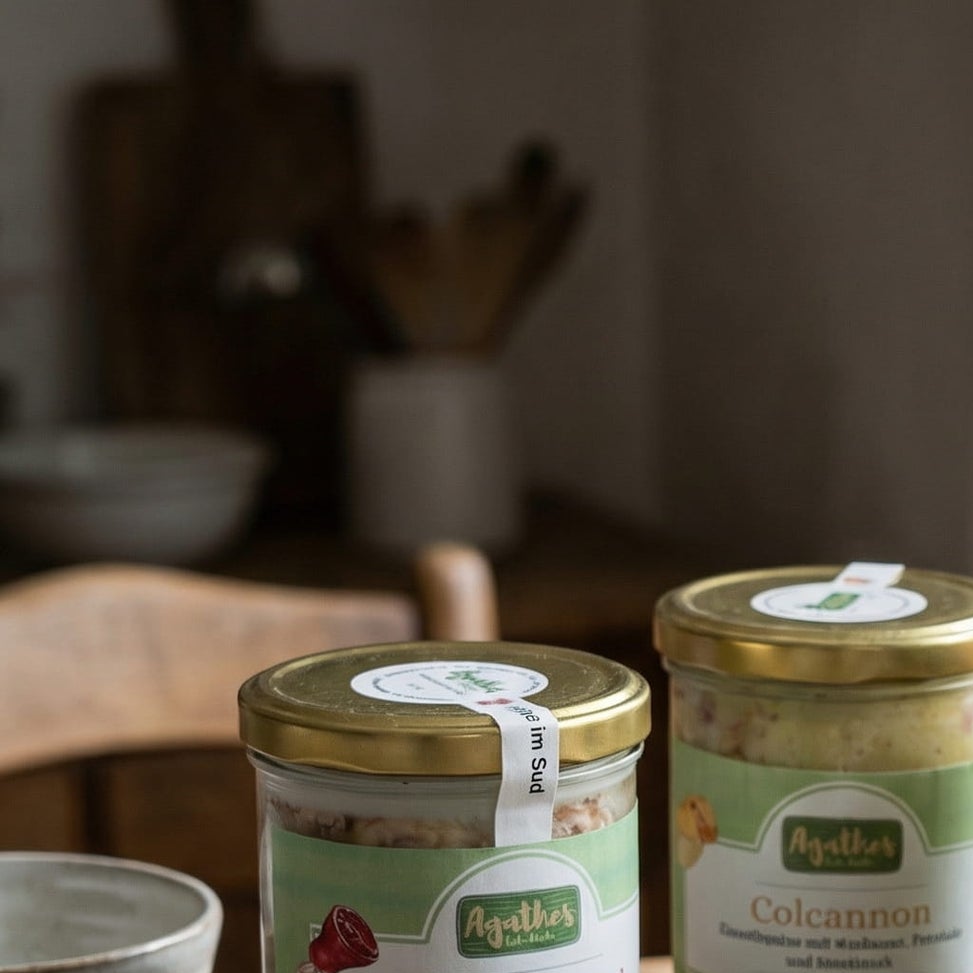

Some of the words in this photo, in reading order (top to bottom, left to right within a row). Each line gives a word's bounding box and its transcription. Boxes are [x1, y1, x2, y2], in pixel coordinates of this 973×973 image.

[530, 727, 546, 750] im
[529, 757, 547, 794] Sud
[464, 899, 577, 949] Agathes
[750, 895, 932, 931] Colcannon
